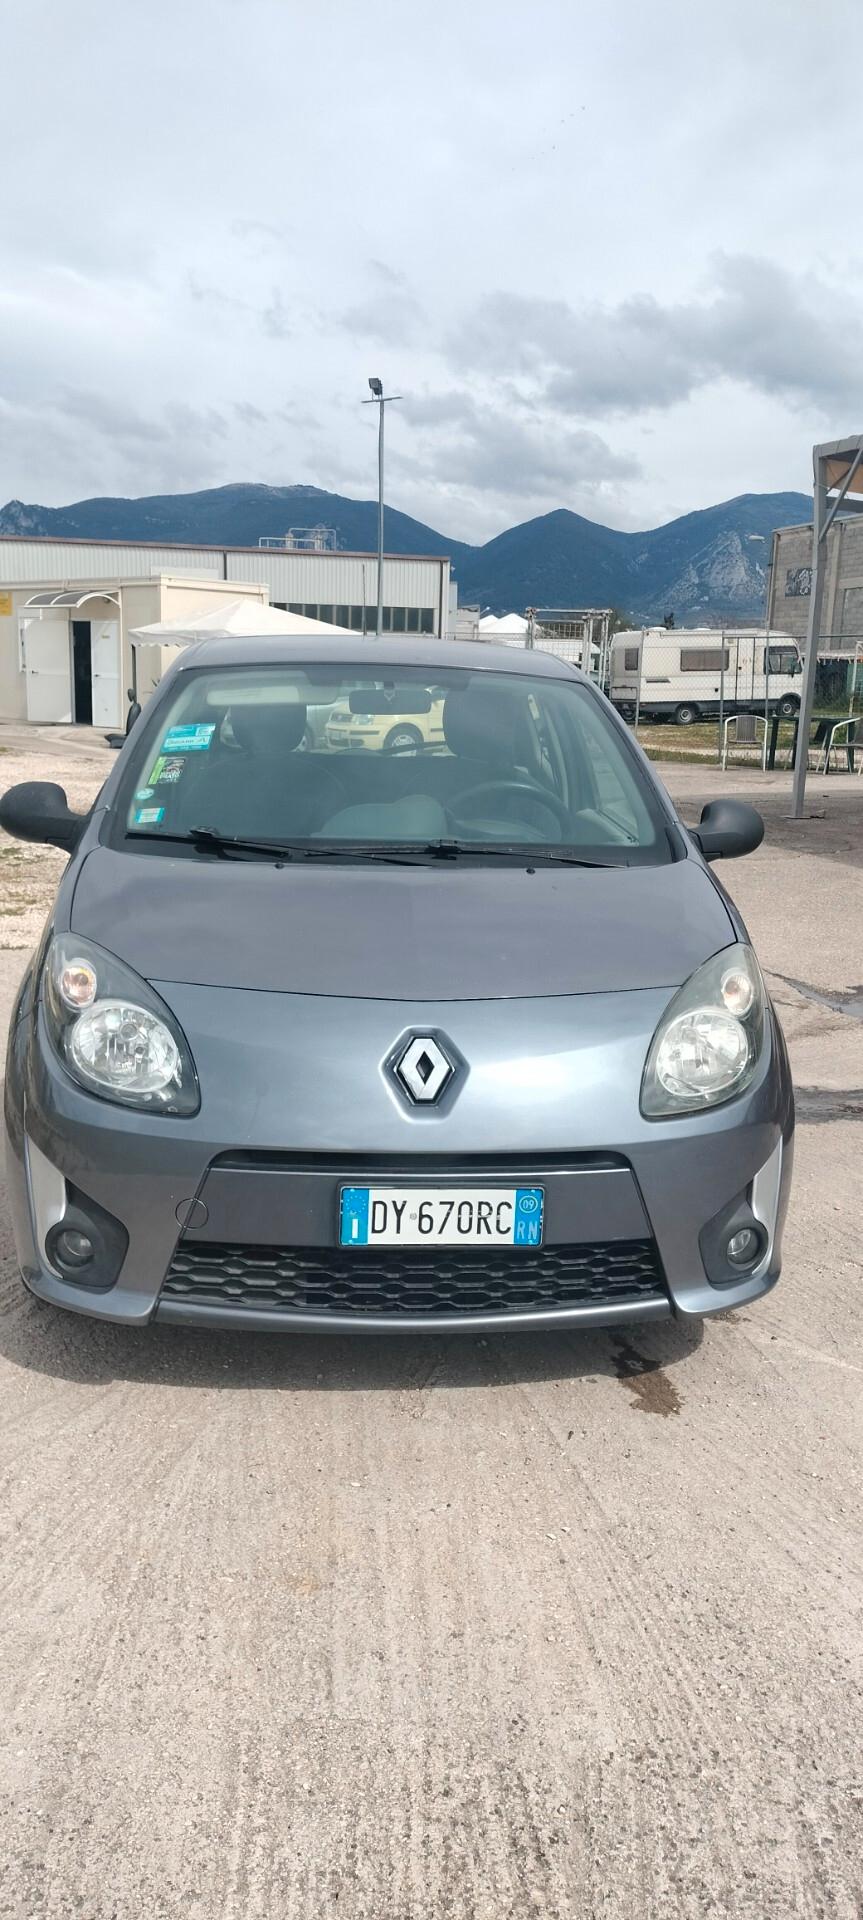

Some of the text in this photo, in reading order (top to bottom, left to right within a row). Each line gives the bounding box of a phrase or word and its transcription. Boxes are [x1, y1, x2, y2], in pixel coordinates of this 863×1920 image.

[523, 1199, 534, 1209] 09
[351, 1218, 359, 1239] I
[517, 1220, 538, 1239] RN
